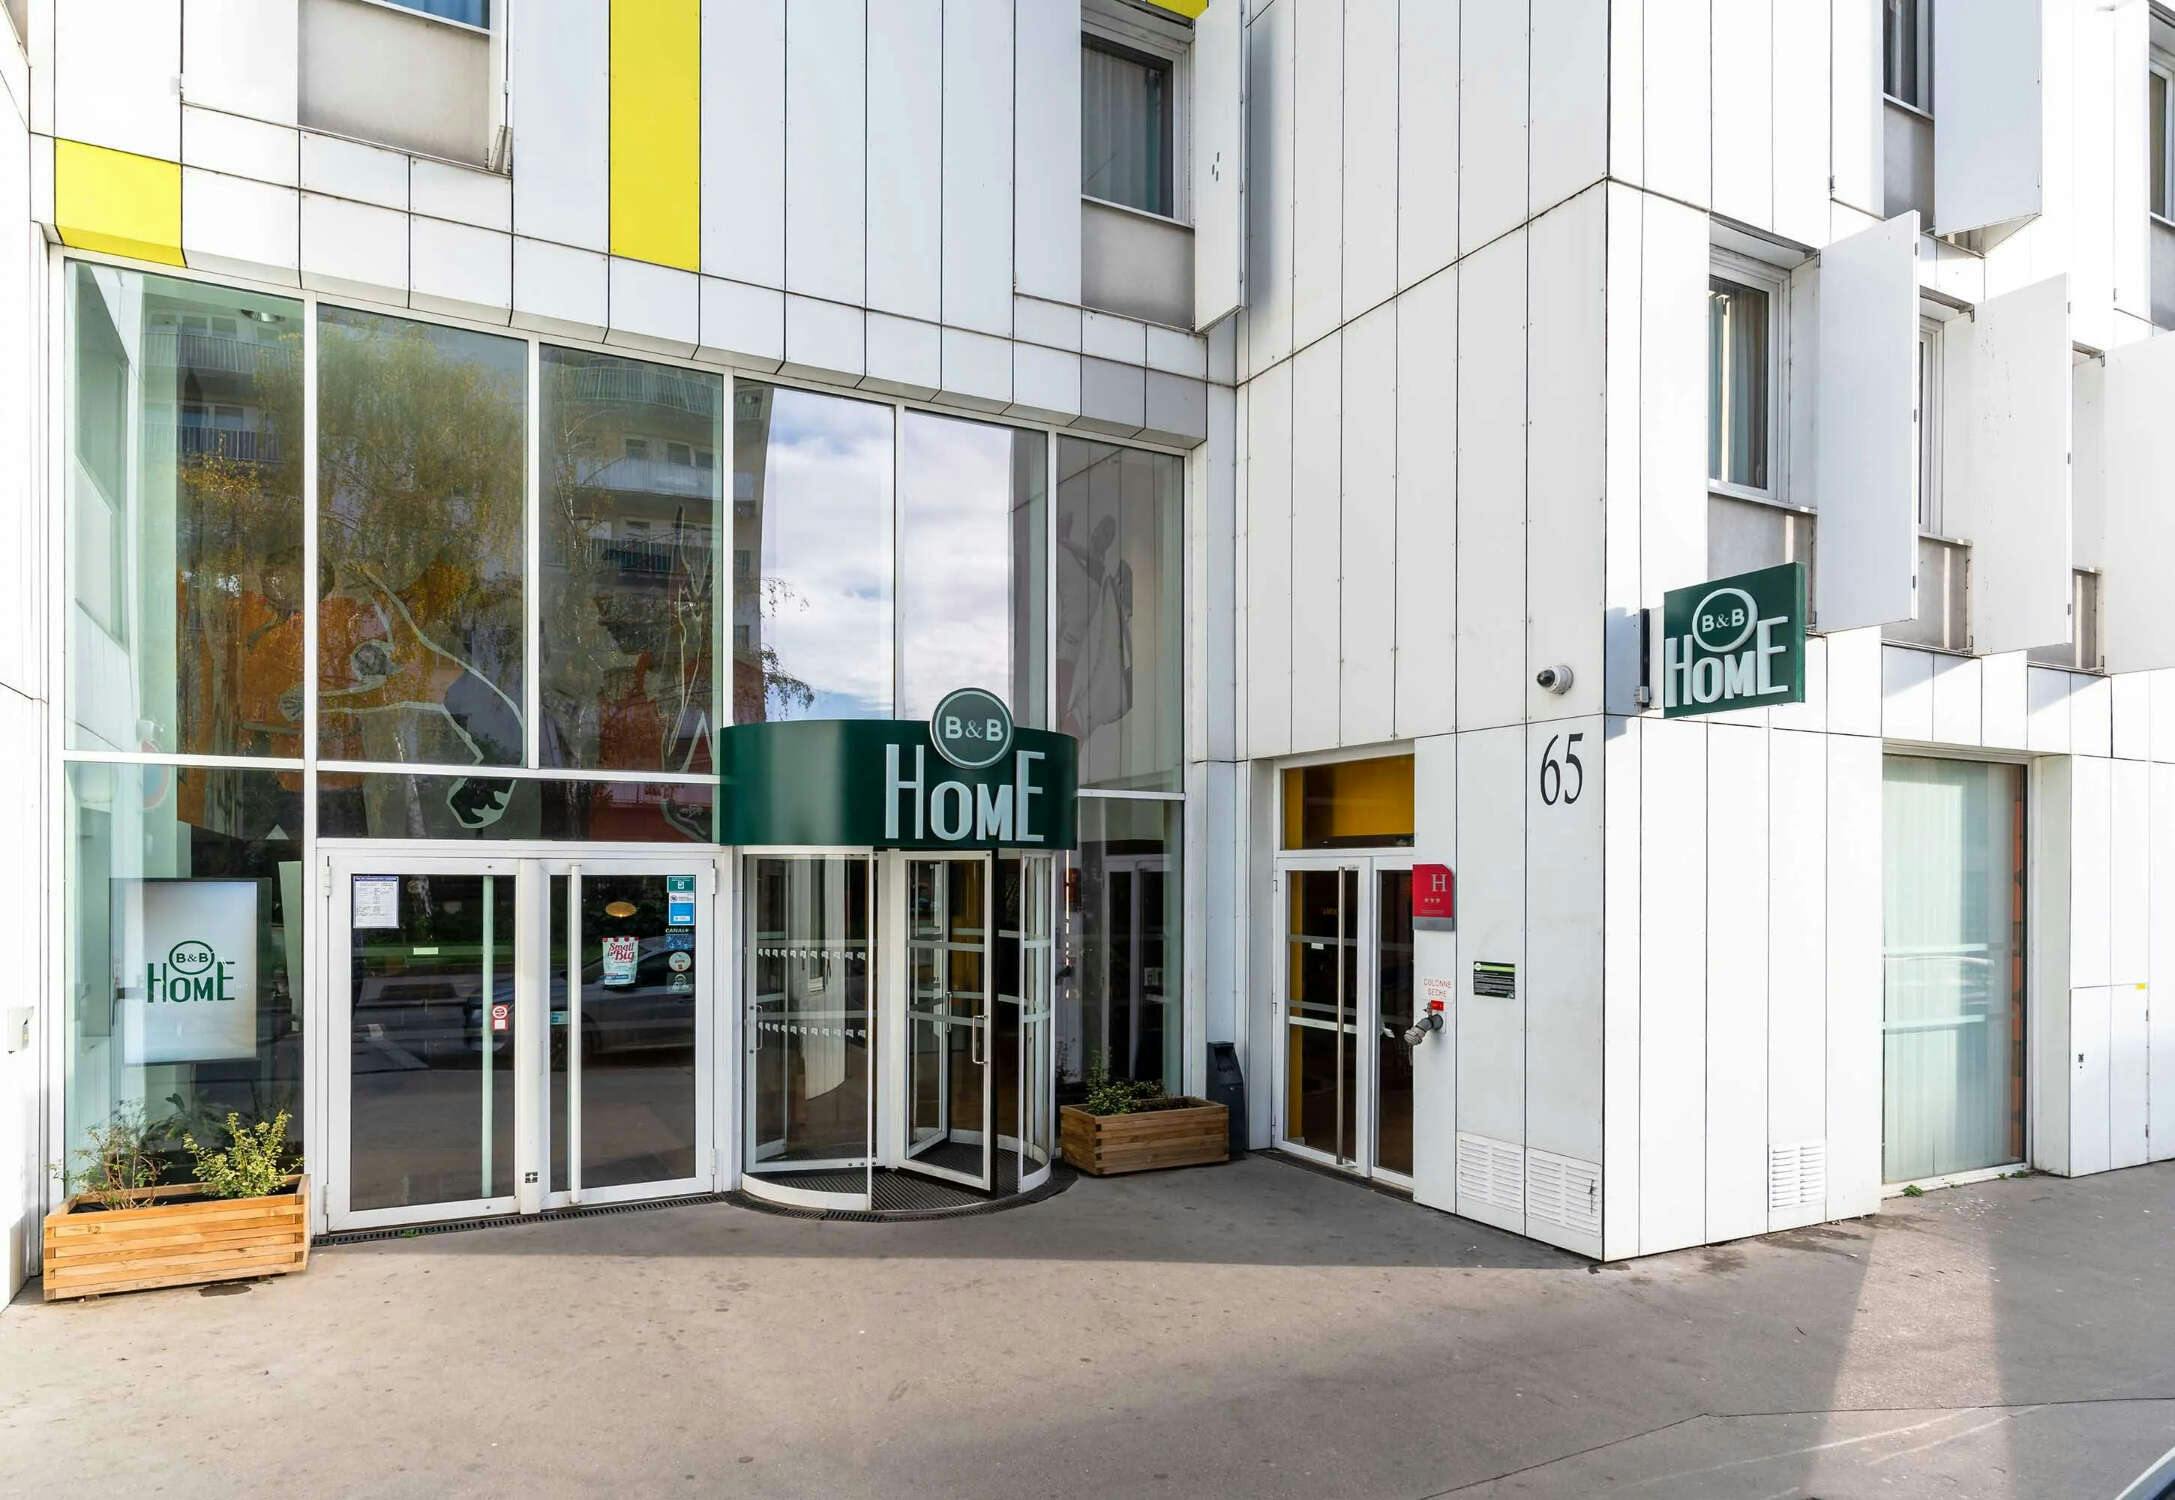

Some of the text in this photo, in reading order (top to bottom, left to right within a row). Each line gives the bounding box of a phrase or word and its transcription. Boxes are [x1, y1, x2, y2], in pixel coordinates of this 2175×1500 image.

[1702, 608, 1745, 633] B&B
[1665, 616, 1788, 708] HOME
[945, 716, 1003, 741] B&B
[1540, 732, 1584, 806] 65
[885, 744, 1045, 842] HOME
[1432, 874, 1447, 892] H
[176, 953, 209, 963] B&B
[609, 942, 634, 952] Small
[611, 949, 634, 963] Big
[147, 962, 235, 1003] HOME
